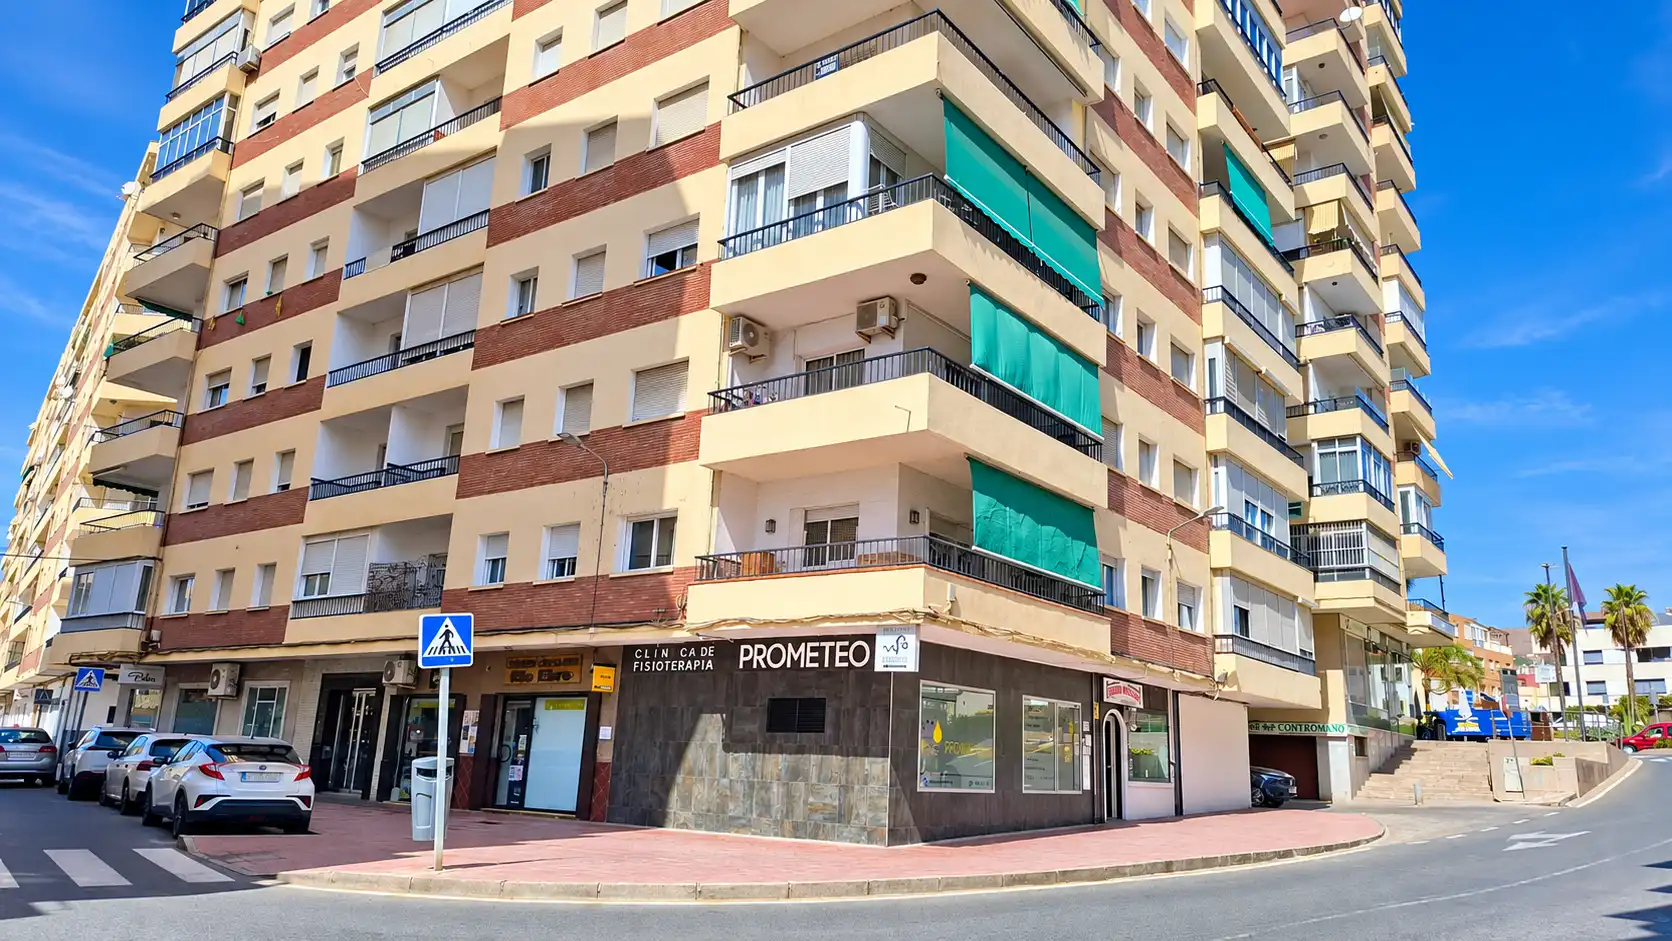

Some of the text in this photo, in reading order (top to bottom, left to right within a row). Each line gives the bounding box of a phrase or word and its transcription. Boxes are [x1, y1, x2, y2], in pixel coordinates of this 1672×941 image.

[700, 646, 715, 657] DE
[738, 640, 871, 669] PROMETEO
[633, 659, 714, 672] FISIOTERAPIA
[1277, 723, 1345, 733] CONTROMANO
